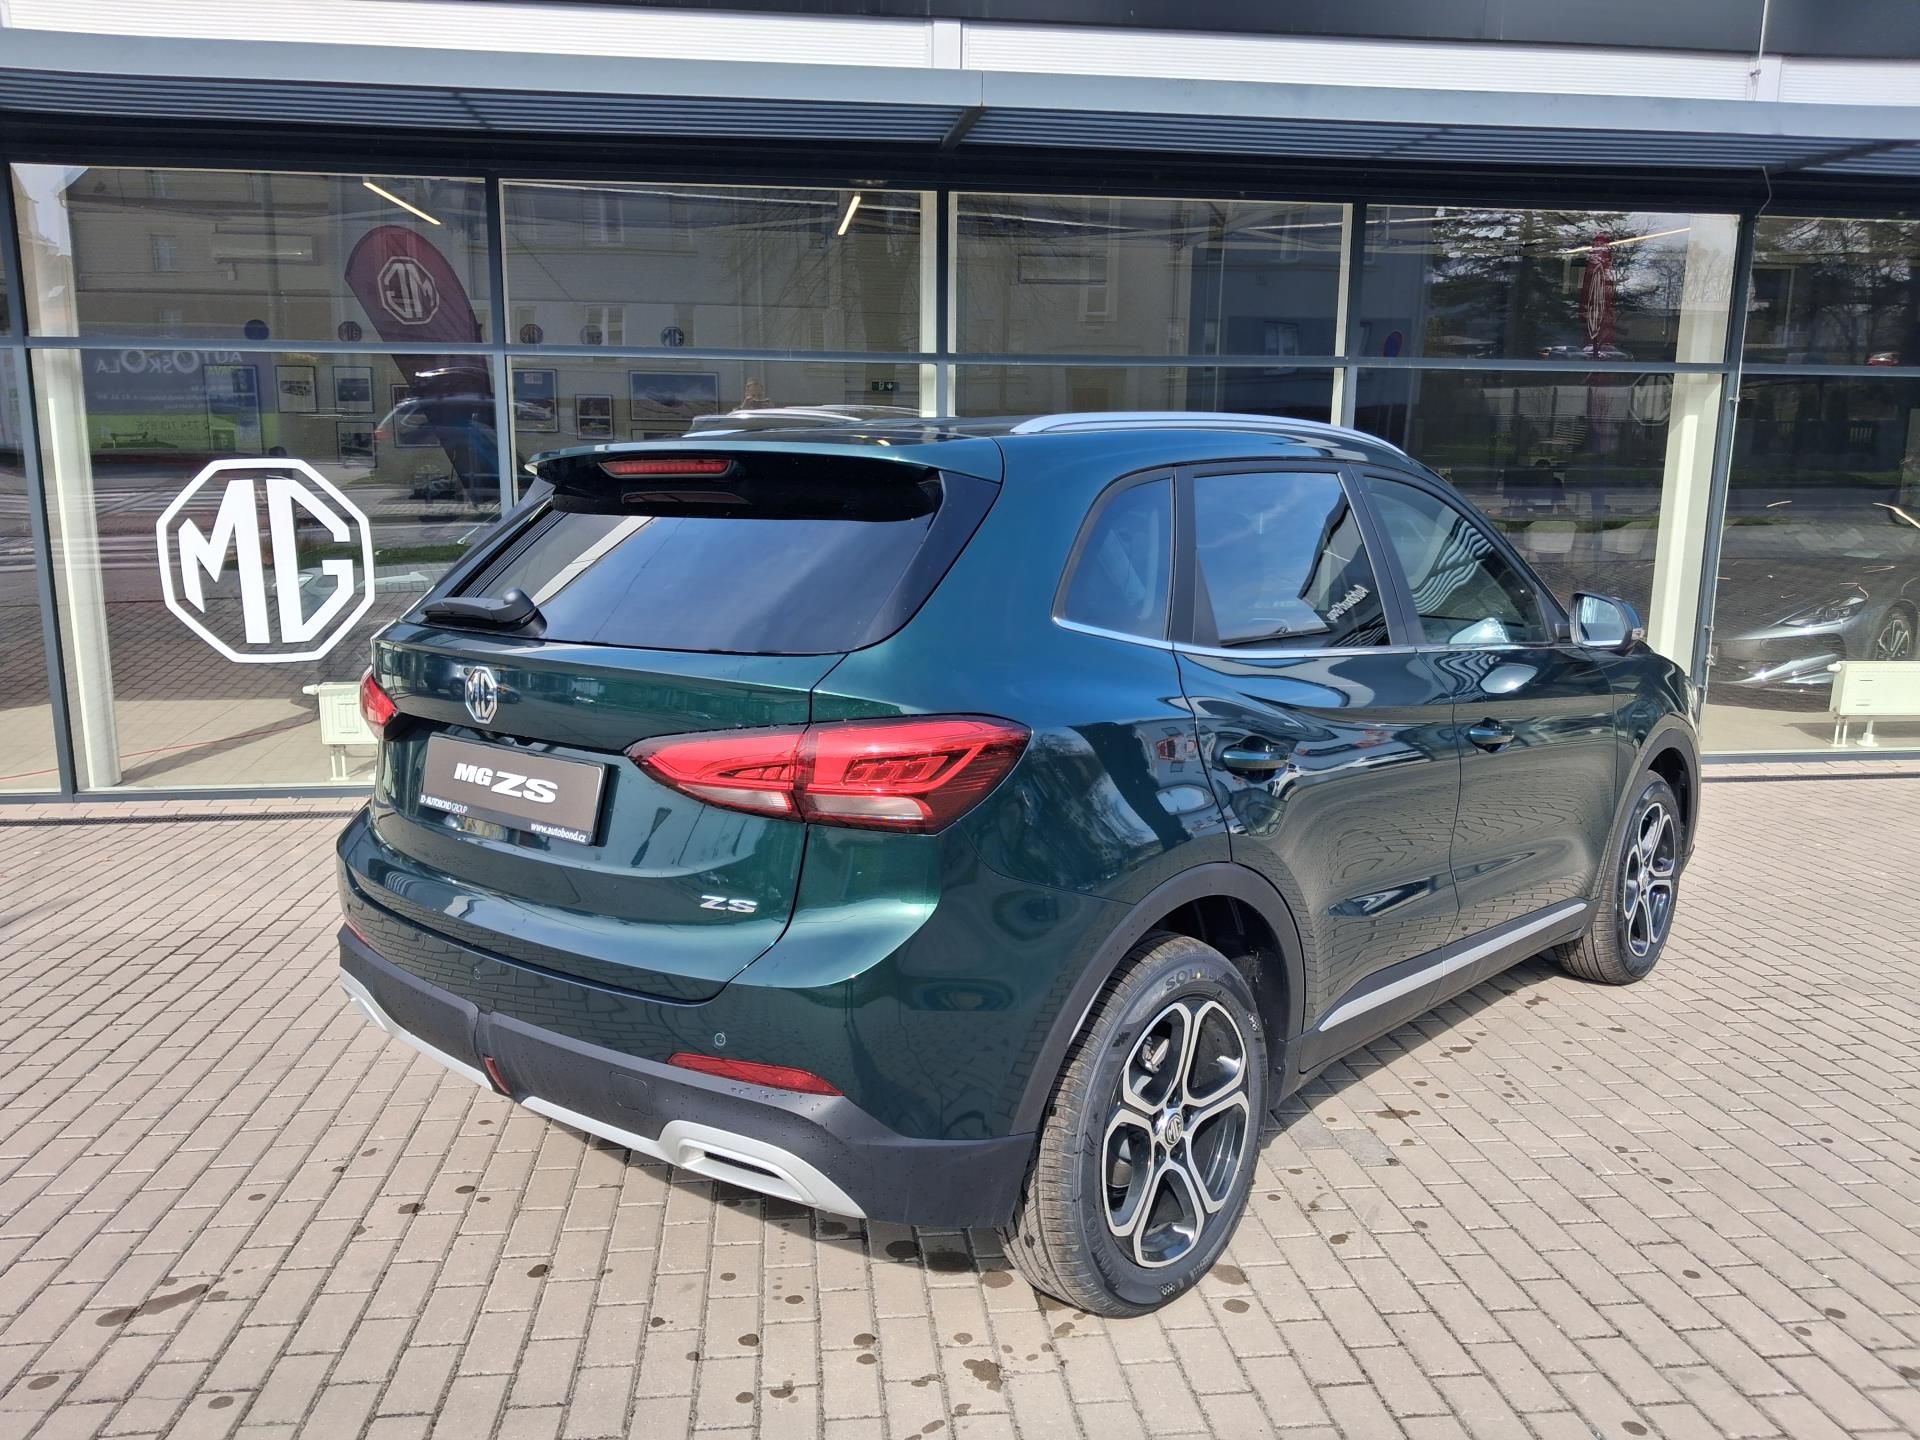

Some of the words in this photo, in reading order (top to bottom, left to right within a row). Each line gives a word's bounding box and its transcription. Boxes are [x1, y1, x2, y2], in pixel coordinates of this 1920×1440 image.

[178, 479, 355, 644] MG
[466, 669, 496, 721] MG
[454, 762, 493, 787] MG
[491, 771, 559, 804] ZS
[530, 823, 587, 843] www.autobond.cz
[700, 895, 757, 913] ZS
